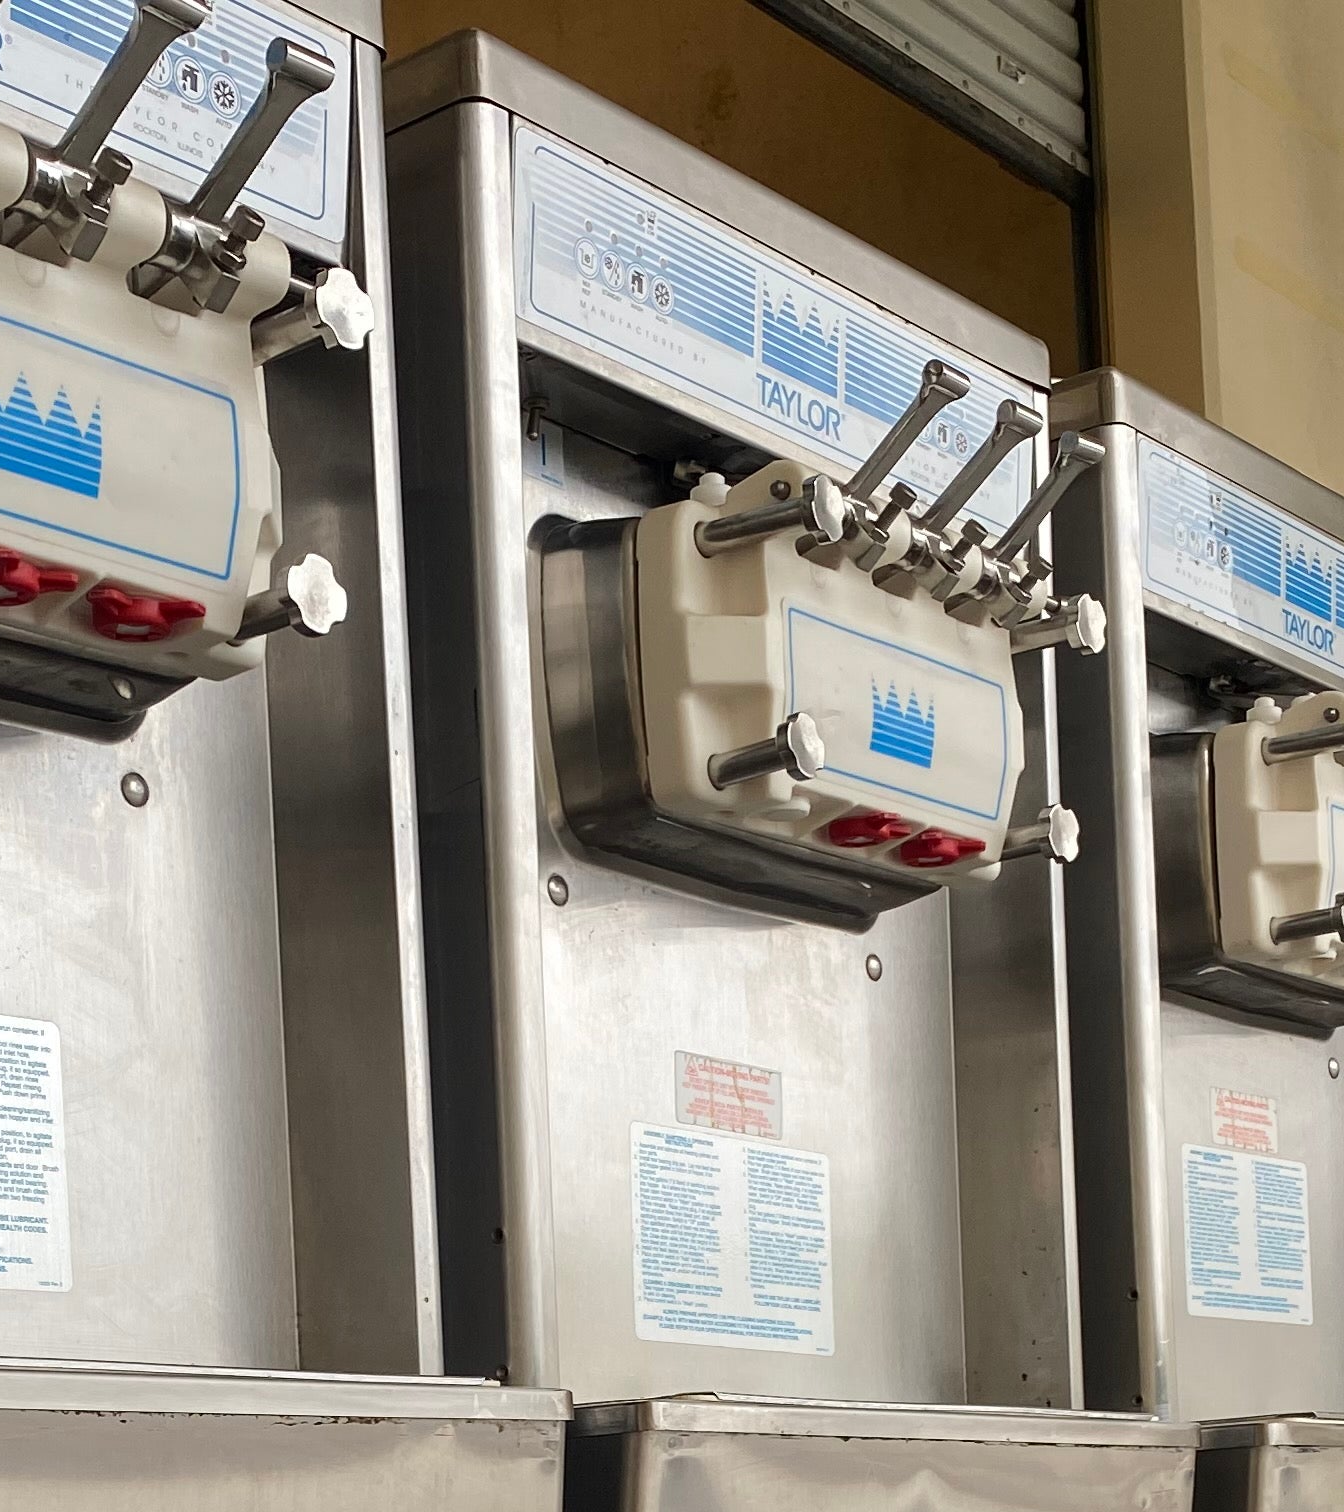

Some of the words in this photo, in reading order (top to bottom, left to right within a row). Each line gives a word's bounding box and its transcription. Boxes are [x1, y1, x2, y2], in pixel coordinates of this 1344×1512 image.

[180, 101, 199, 115] WASH
[215, 118, 233, 130] AUTO
[579, 299, 685, 355] MANUFACTURED
[693, 352, 707, 365] BY
[756, 372, 841, 442] TAYLOR
[1282, 607, 1335, 656] TAYLOR
